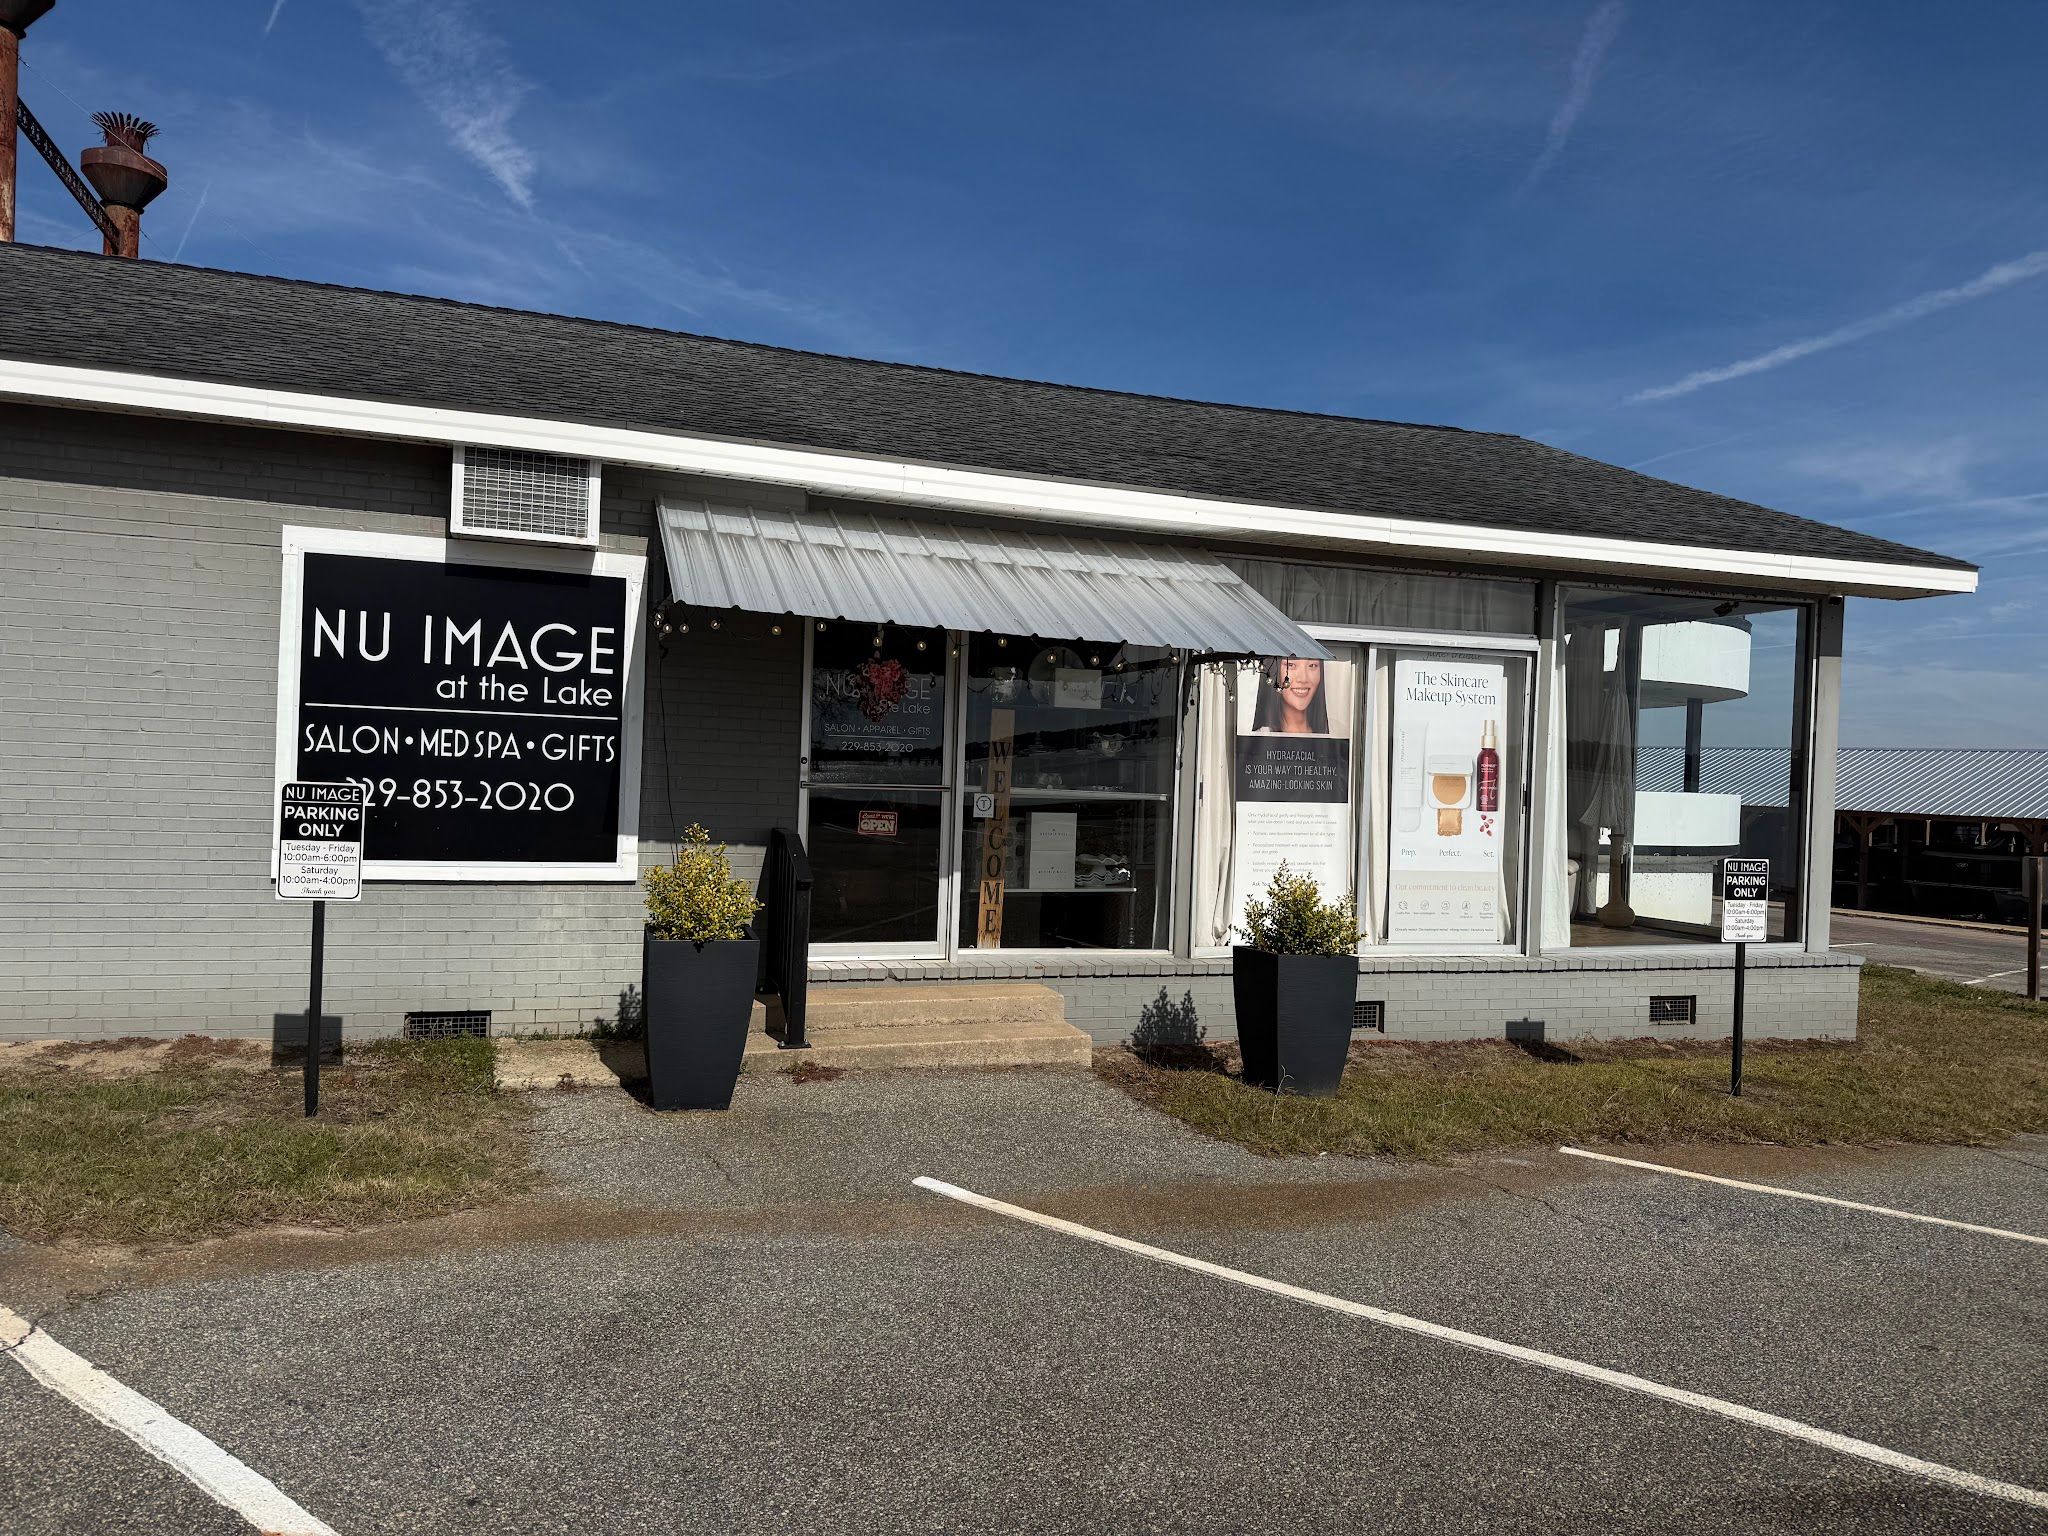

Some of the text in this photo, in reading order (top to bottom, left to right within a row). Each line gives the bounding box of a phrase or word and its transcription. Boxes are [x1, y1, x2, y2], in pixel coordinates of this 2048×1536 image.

[313, 607, 615, 675] NU IMAGE
[1415, 671, 1489, 689] The Skincare
[436, 674, 613, 707] at the Lake
[1406, 687, 1496, 707] Makeup System
[903, 703, 931, 714] Lake
[824, 723, 931, 736] SALON APPAREL GIFTS
[304, 723, 616, 763] SALON MED SPA GIFTS
[841, 741, 914, 753] 229-853-2020
[1266, 750, 1316, 762] HYDRAFACIAL
[1245, 764, 1252, 775] IS
[1253, 764, 1273, 775] YOUR
[1275, 765, 1292, 775] WAY
[1294, 765, 1303, 776] TO
[1316, 780, 1333, 791] SKIN
[286, 786, 360, 802] NU IMAGE
[346, 777, 575, 812] 29-853-2020
[285, 805, 360, 821] PARKING
[298, 822, 345, 838] ONLY
[860, 819, 896, 832] OPEN
[286, 842, 321, 853] Tuesday
[328, 844, 356, 854] Friday
[283, 853, 358, 864] 10:00am-6:00pm
[300, 866, 339, 876] Saturday
[1727, 862, 1766, 871] NU IMAGE
[282, 875, 357, 886] 10:00am-4:00pm
[1727, 876, 1766, 885] PARKING
[1734, 888, 1758, 897] ONLY
